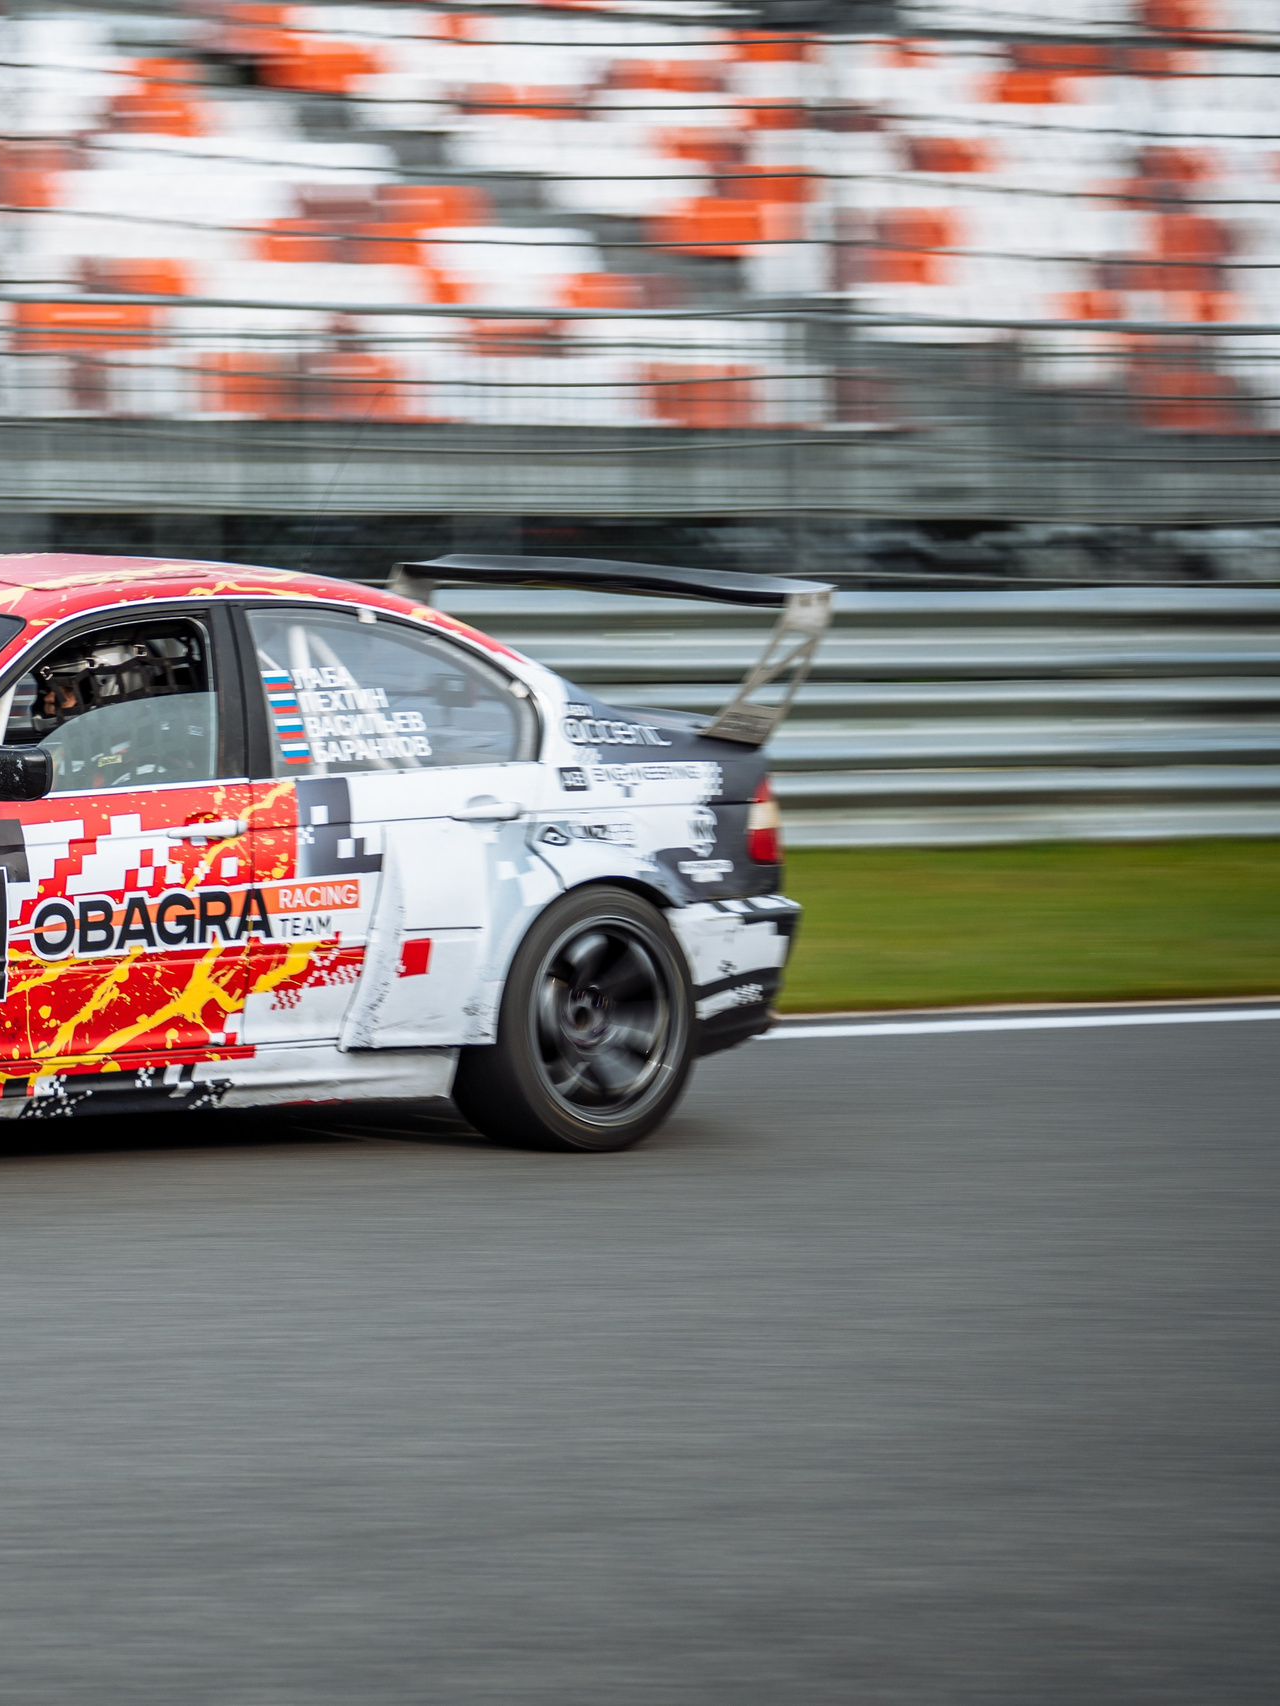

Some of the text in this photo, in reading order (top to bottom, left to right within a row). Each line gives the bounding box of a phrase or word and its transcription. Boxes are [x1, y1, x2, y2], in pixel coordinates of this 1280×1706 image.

[279, 884, 358, 909] RACING
[34, 888, 275, 956] OBAGRA
[279, 915, 332, 937] TEAM
